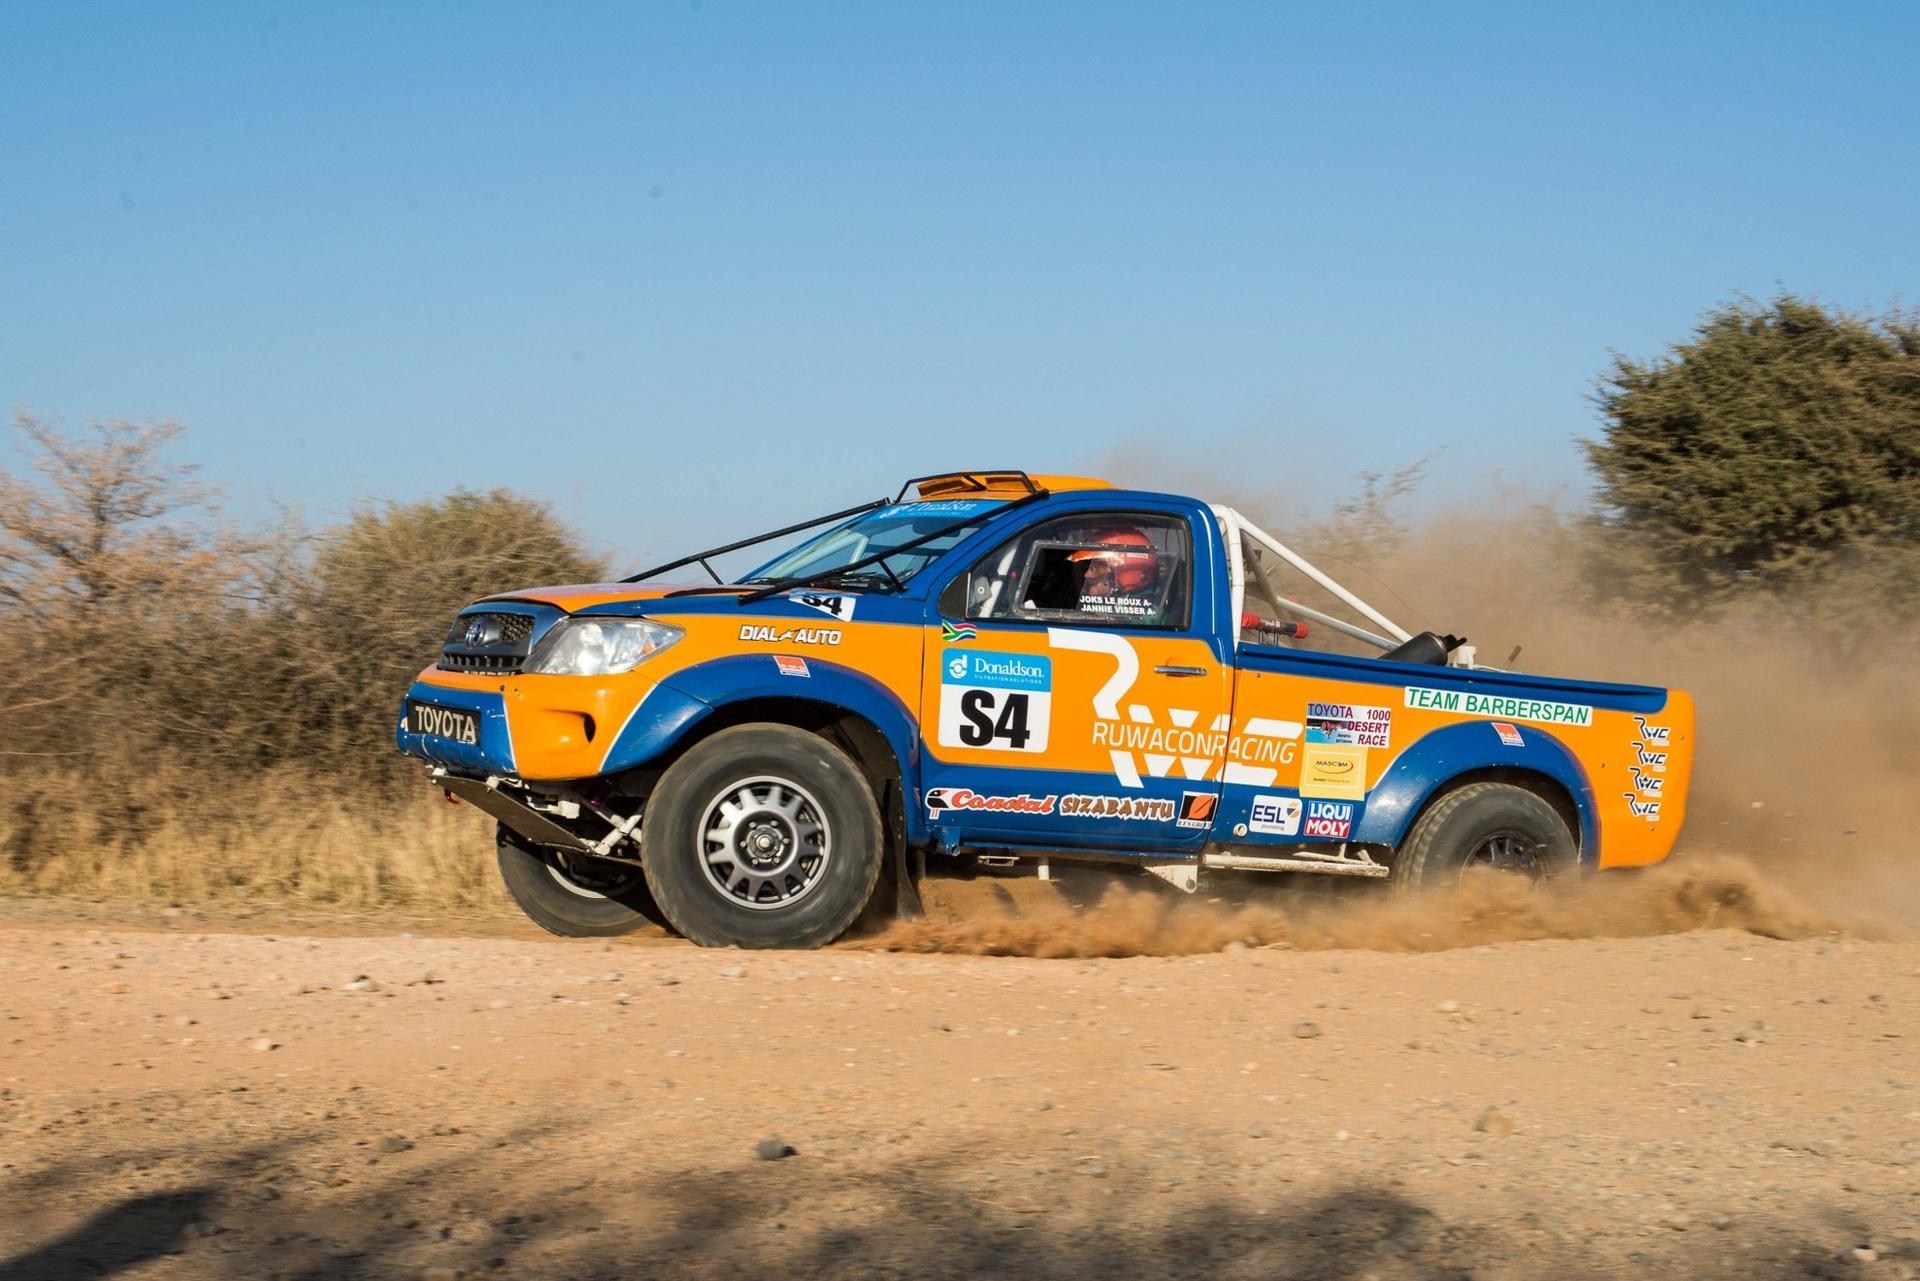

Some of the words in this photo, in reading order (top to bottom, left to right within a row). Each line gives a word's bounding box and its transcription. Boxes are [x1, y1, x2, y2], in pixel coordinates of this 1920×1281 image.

[1080, 595, 1103, 604] JOKS
[1105, 596, 1116, 605] LE
[1117, 597, 1141, 606] ROUX
[1081, 604, 1113, 613] JANNIE
[1114, 606, 1146, 615] VISSER
[739, 624, 779, 642] DIAL
[793, 627, 842, 645] AUTO
[974, 657, 1042, 678] Donaldson
[1307, 703, 1354, 719] TOYOTA
[1366, 708, 1391, 722] 1000
[1408, 688, 1460, 711] TEAM
[1464, 694, 1589, 725] BARBERSPAN
[415, 705, 477, 745] TOYOTA
[959, 689, 1031, 749] S4
[1346, 720, 1389, 734] DESERT
[1357, 733, 1387, 747] RACE
[1061, 795, 1174, 820] SIZABANTU
[1252, 804, 1285, 824] ESL
[1309, 802, 1351, 820] LIQUI
[1305, 819, 1349, 838] MOLY
